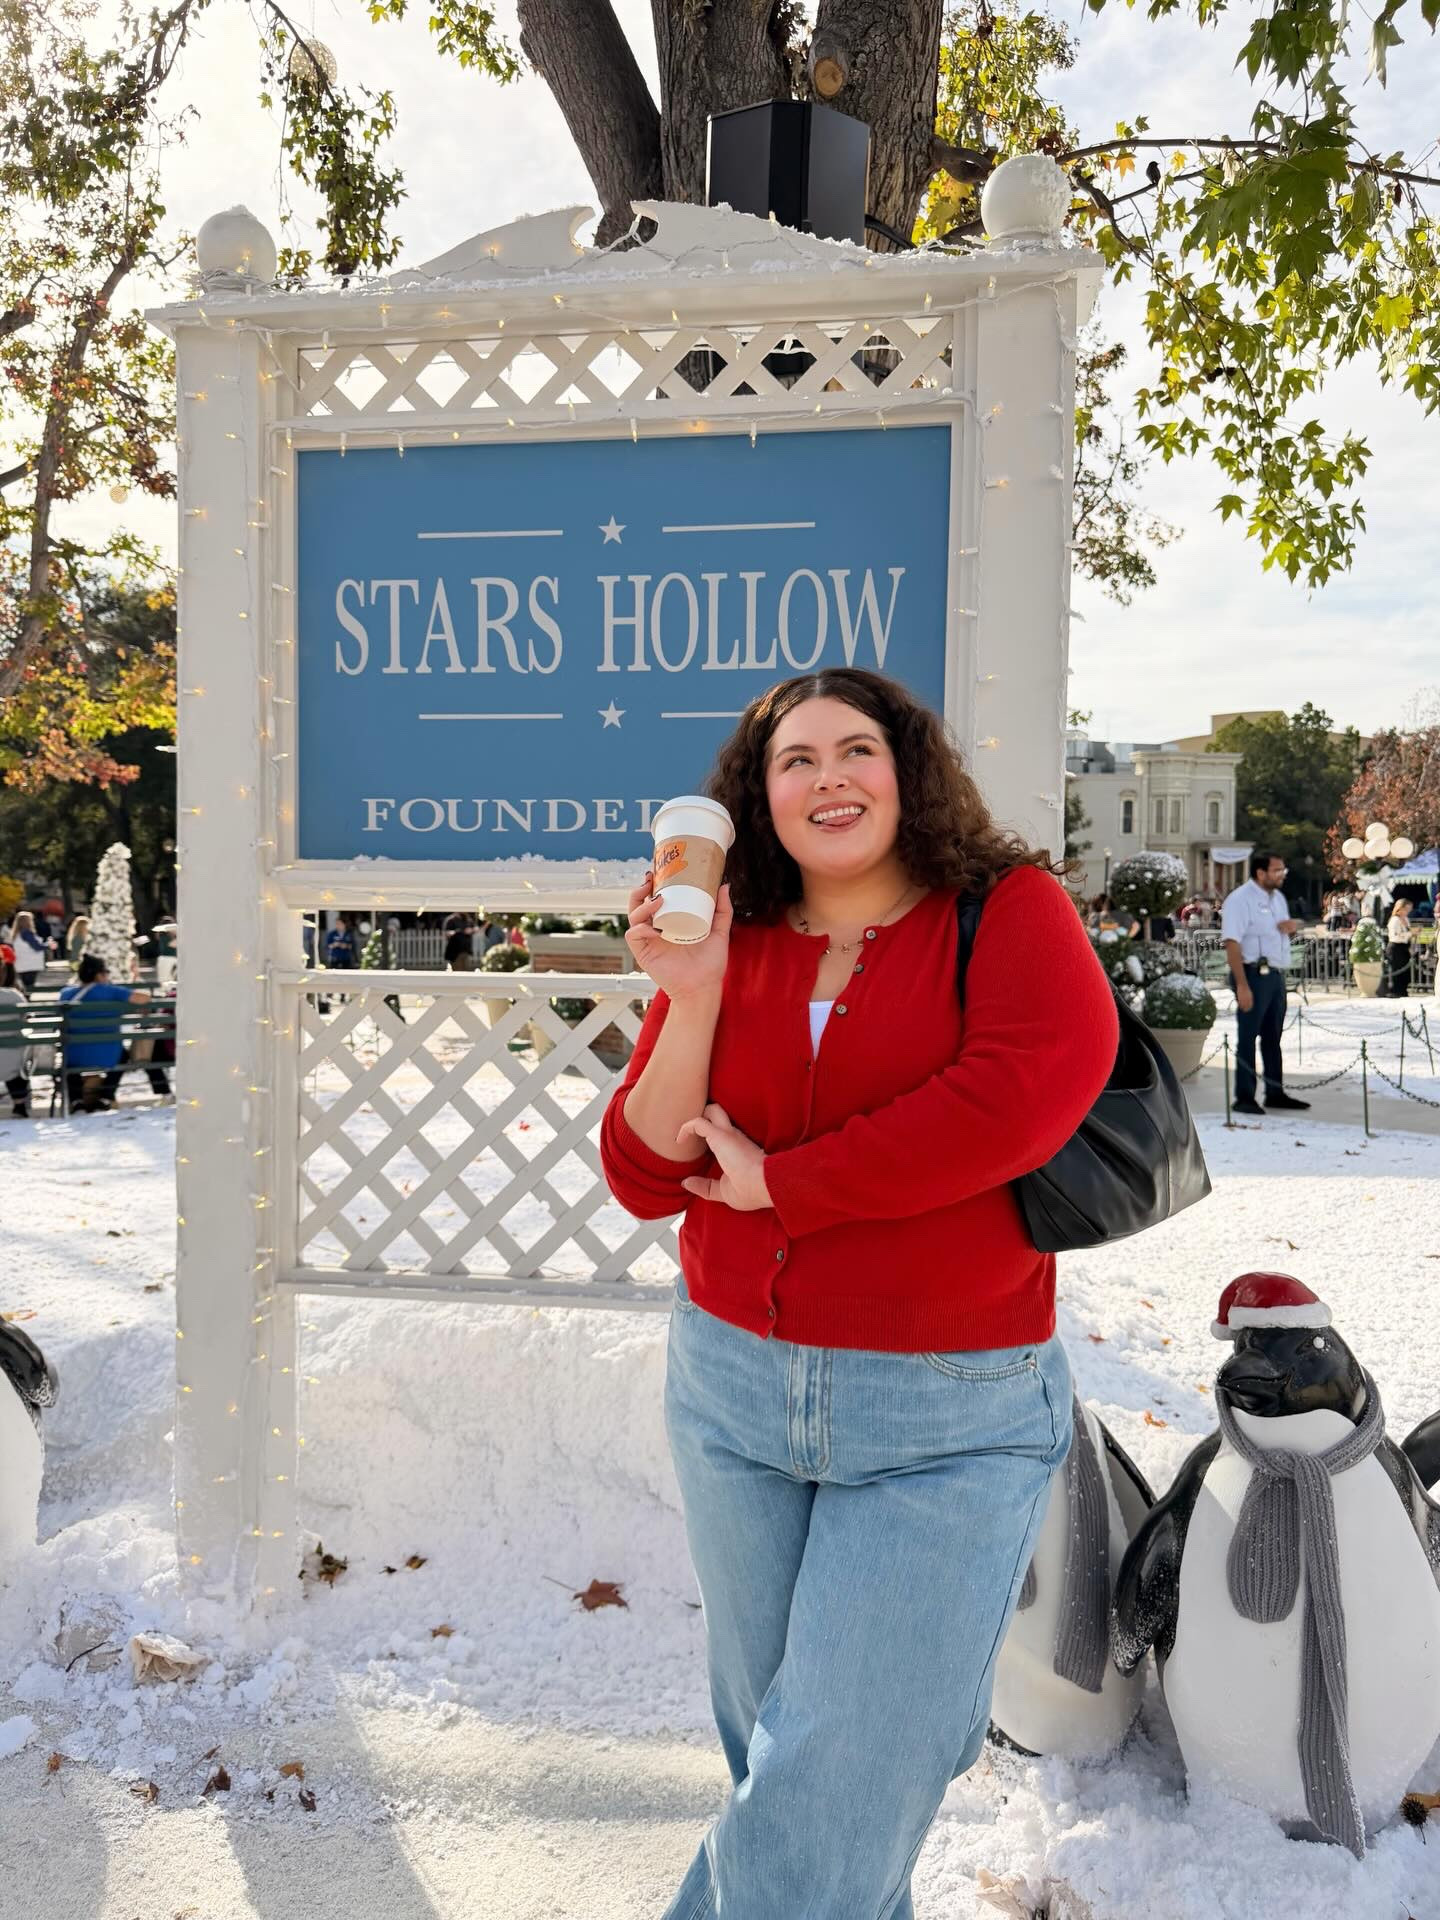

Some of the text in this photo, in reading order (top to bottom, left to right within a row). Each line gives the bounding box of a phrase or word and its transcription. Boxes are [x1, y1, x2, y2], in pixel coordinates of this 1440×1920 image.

[334, 567, 906, 676] STARS HOLLOW
[656, 845, 680, 871] uke's
